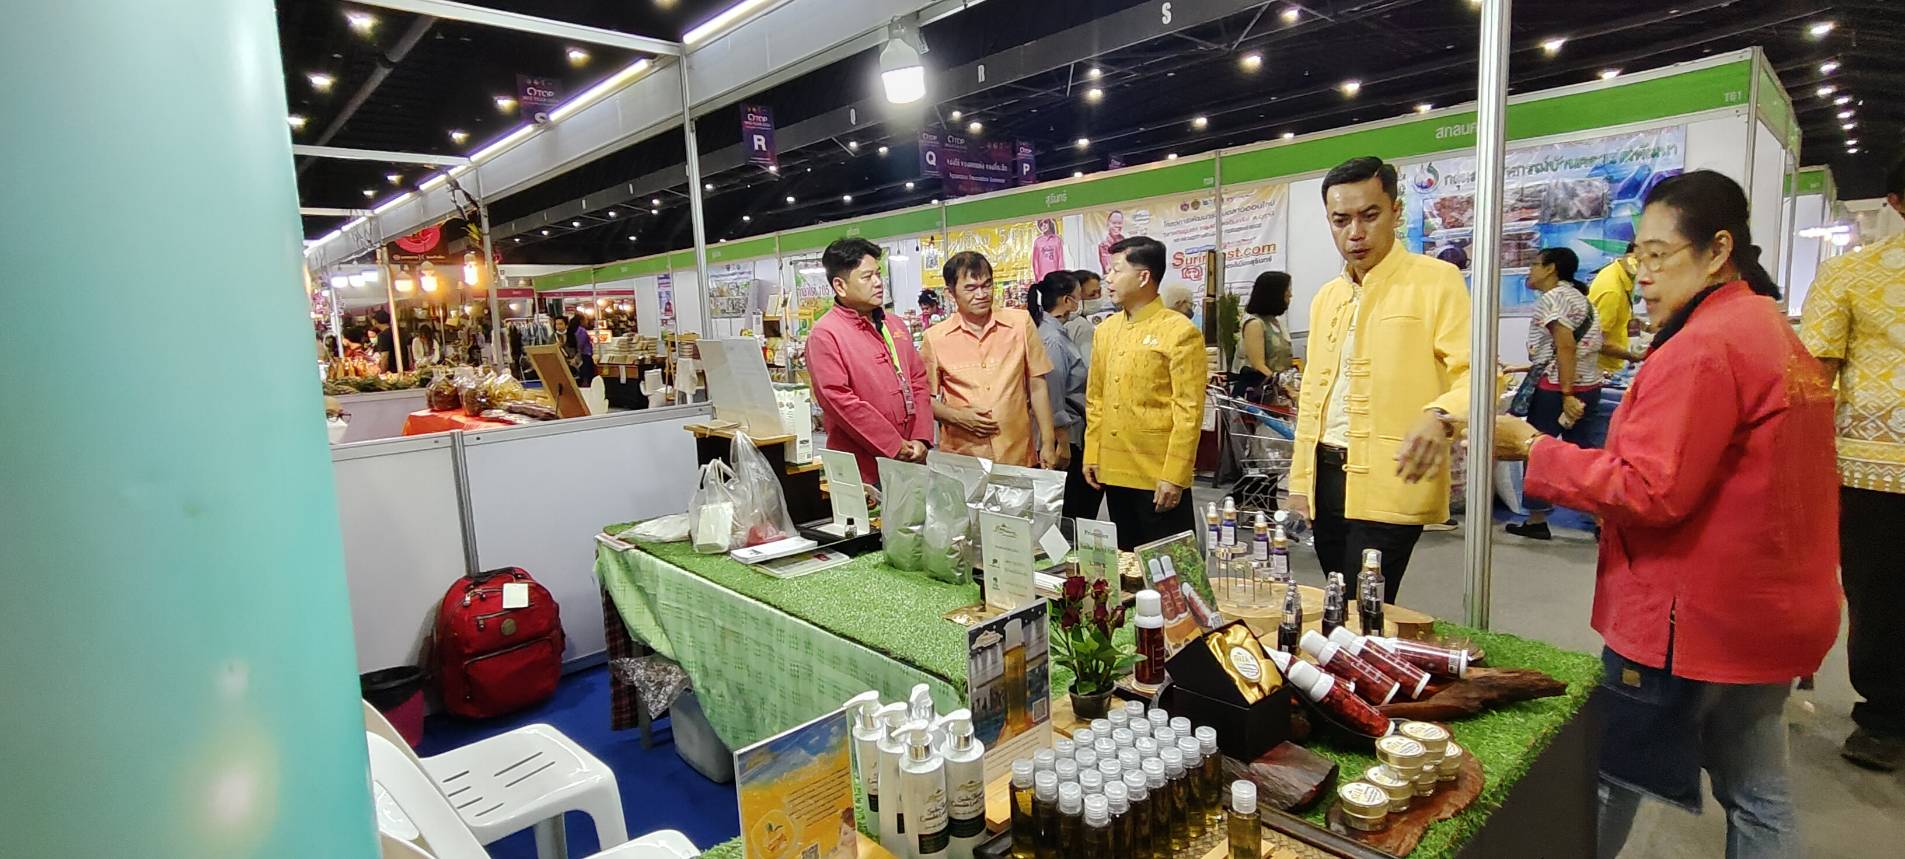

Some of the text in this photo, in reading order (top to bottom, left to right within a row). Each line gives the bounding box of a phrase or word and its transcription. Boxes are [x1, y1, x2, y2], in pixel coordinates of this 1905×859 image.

[1161, 2, 1172, 24] S
[747, 113, 768, 122] OTOP
[753, 134, 768, 151] R
[925, 150, 937, 166] Q
[1023, 163, 1031, 176] P
